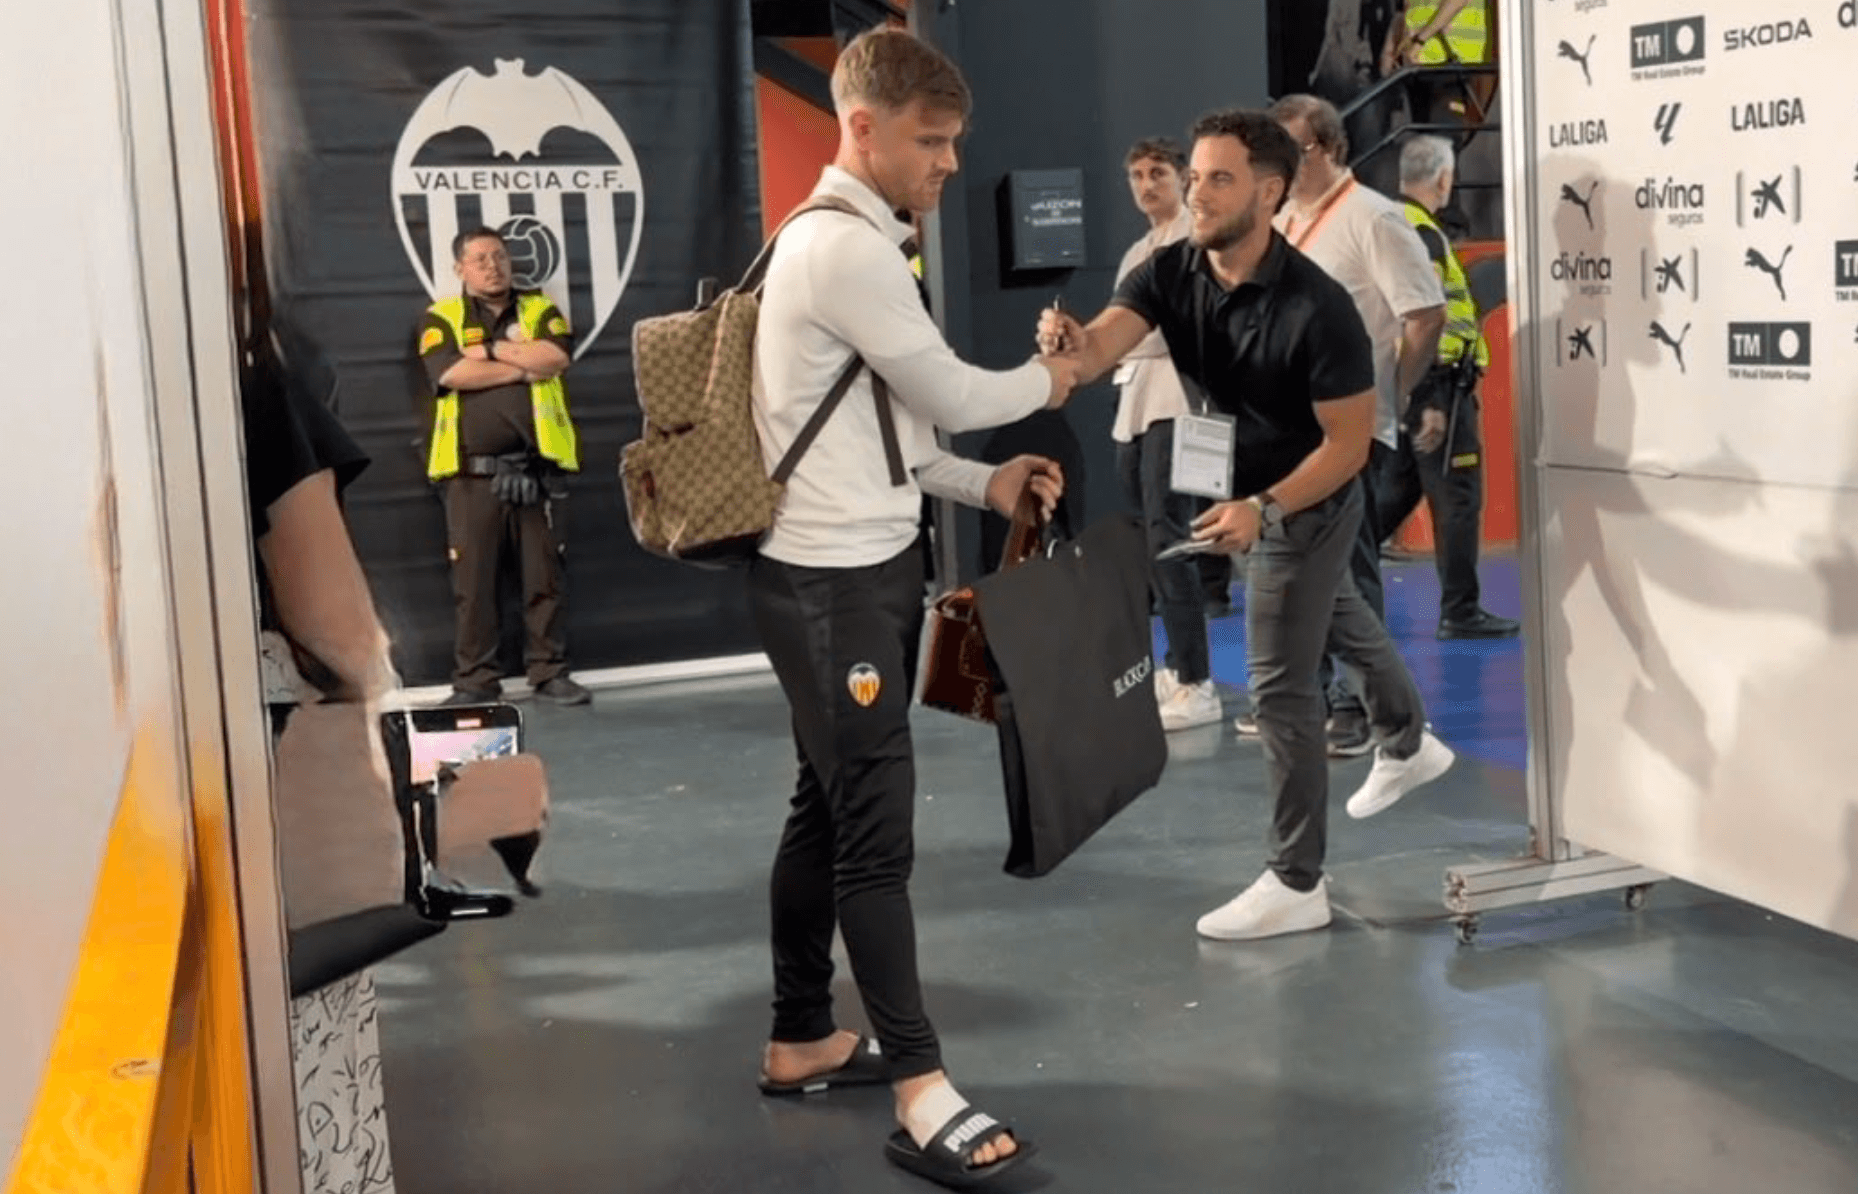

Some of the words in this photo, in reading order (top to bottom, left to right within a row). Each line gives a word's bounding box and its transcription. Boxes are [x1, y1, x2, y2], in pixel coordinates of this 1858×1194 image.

[1634, 34, 1661, 59] TM
[1723, 18, 1812, 51] SKODA
[1731, 97, 1806, 131] LALIGA
[1549, 119, 1608, 148] LALIGA
[415, 171, 562, 191] VALENCIA
[572, 170, 624, 190] C.F.
[1634, 176, 1704, 209] divina
[1667, 213, 1704, 228] seguros
[1550, 251, 1612, 281] divina
[1732, 333, 1760, 357] TM
